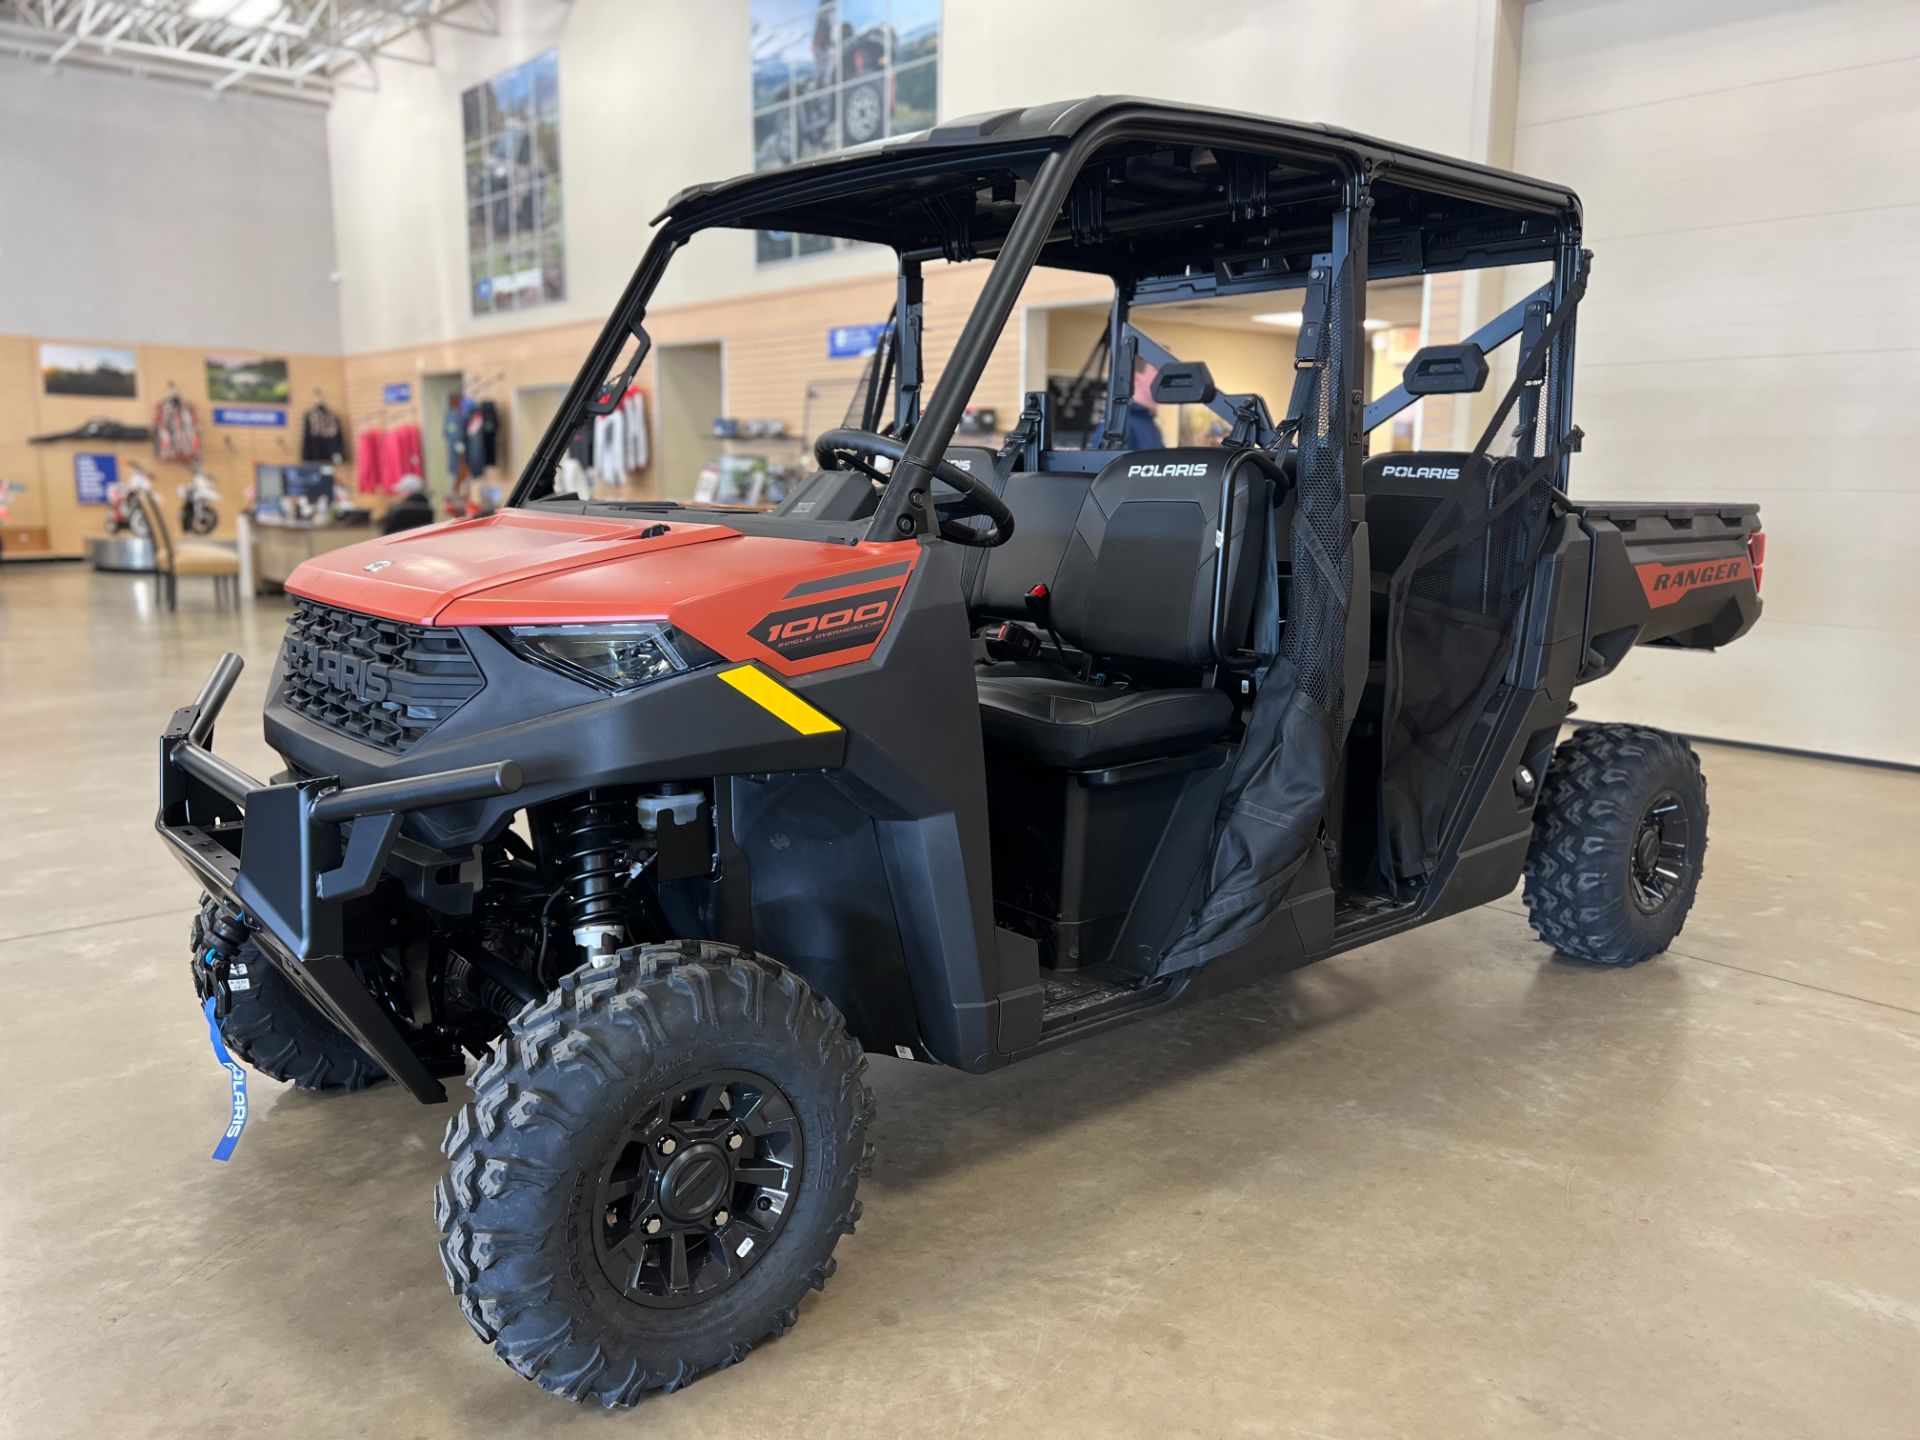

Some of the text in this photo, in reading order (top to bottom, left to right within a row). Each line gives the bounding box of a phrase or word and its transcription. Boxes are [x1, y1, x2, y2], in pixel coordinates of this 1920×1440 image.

[1128, 464, 1208, 477] POLARIS
[1382, 466, 1460, 480] POLARIS
[1653, 562, 1741, 591] RANGER
[767, 601, 888, 642] 1000
[777, 619, 885, 648] SINGLE OVERHEAD CAM
[284, 635, 388, 702] POLARIS
[223, 1062, 246, 1137] POLARIS
